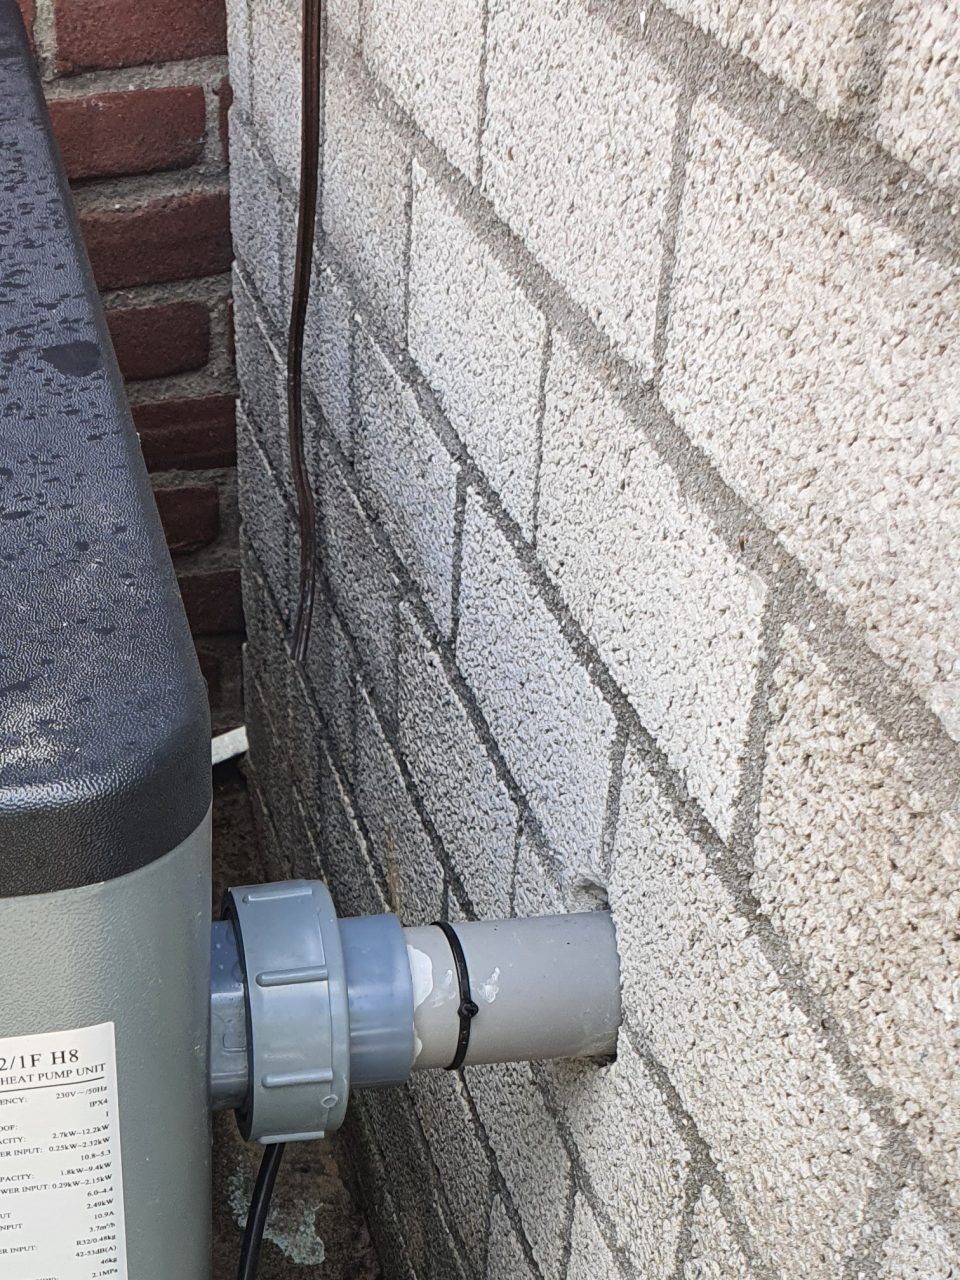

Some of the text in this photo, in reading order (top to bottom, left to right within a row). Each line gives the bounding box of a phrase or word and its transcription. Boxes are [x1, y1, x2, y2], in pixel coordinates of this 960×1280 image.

[51, 1049, 79, 1065] H8
[0, 1074, 34, 1085] HEAT
[38, 1069, 72, 1081] PUMP
[77, 1063, 106, 1076] UNIT
[89, 1098, 108, 1108] IPX4
[14, 1147, 43, 1156] INPUT:
[10, 1245, 38, 1253] INPUT:
